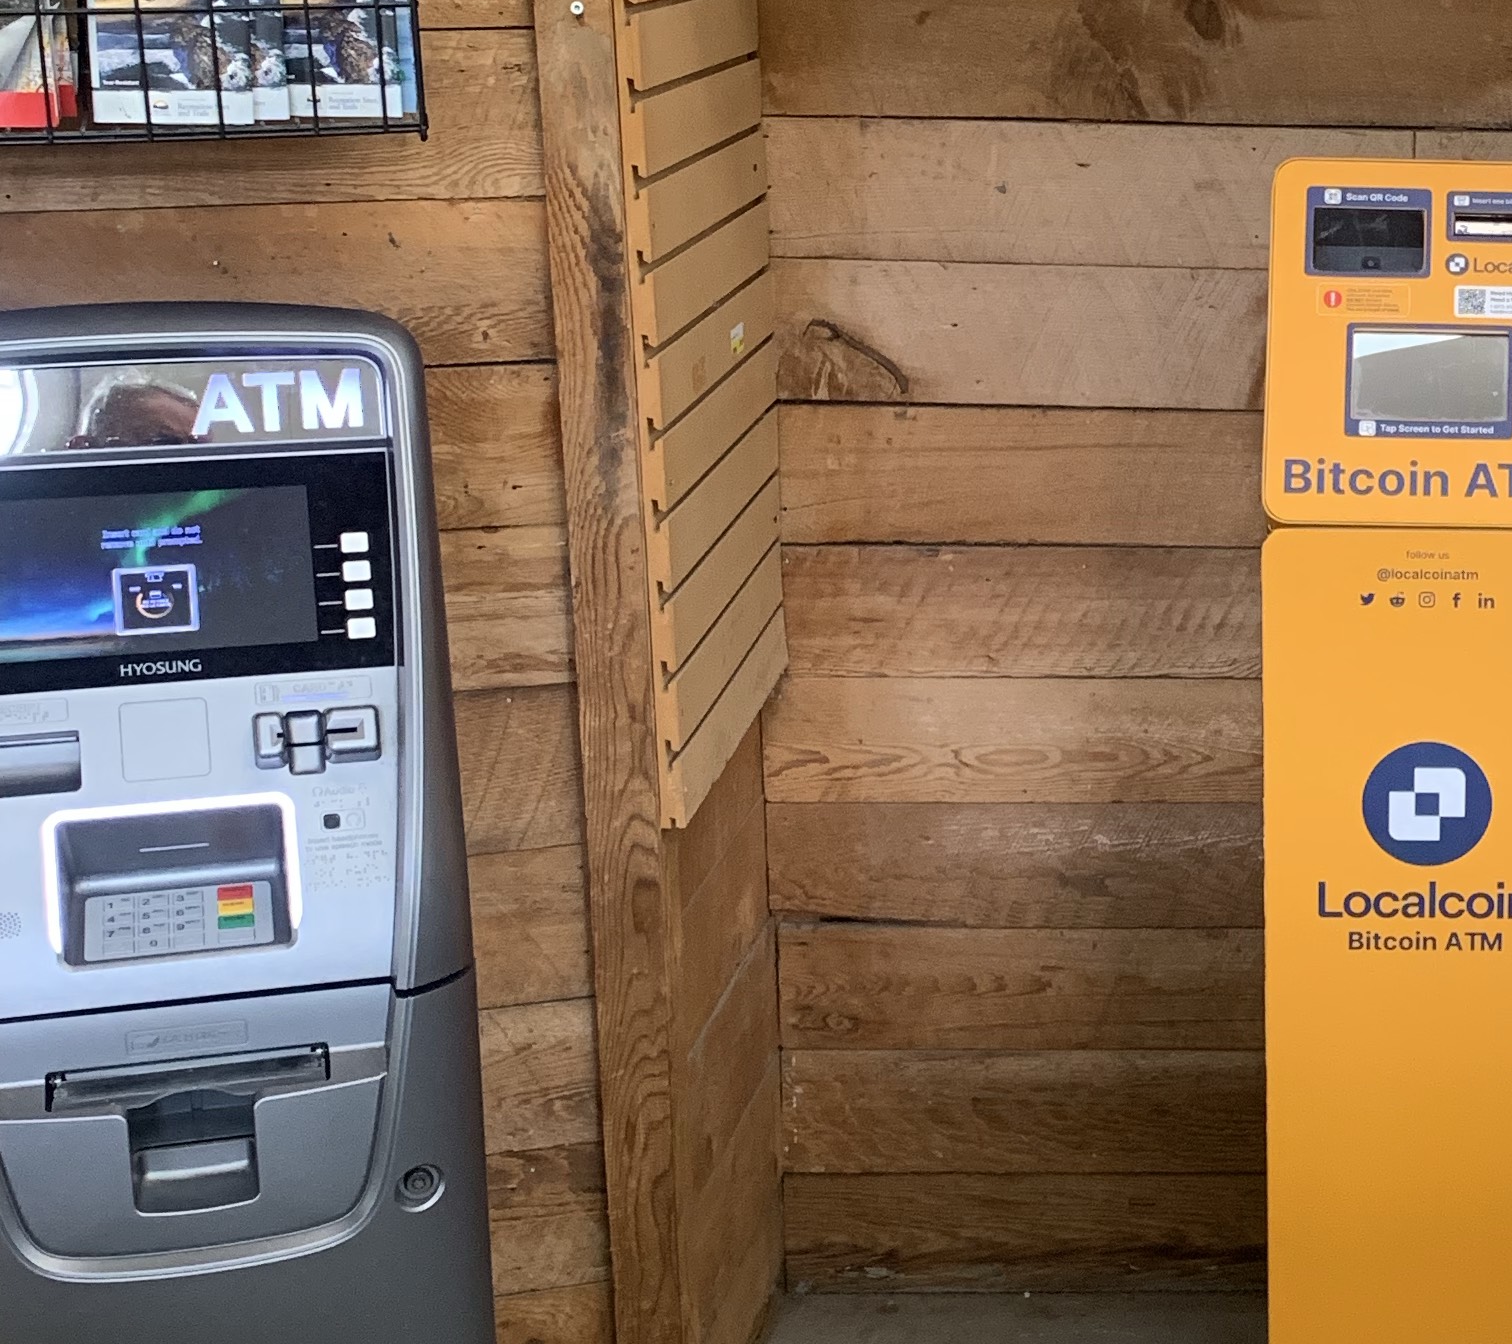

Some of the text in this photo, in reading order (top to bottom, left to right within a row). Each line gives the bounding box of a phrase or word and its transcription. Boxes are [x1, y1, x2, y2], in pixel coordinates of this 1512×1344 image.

[1346, 193, 1409, 202] Scan QR Code
[193, 368, 364, 436] ATM
[1380, 424, 1494, 434] Tap Screen to Get Started
[1283, 458, 1449, 497] Bitcoin
[1405, 549, 1450, 560] follow us
[1377, 568, 1479, 583] @localcoinatm
[119, 659, 203, 677] HYOSUNG
[1347, 930, 1503, 952] Bitcoin ATM
